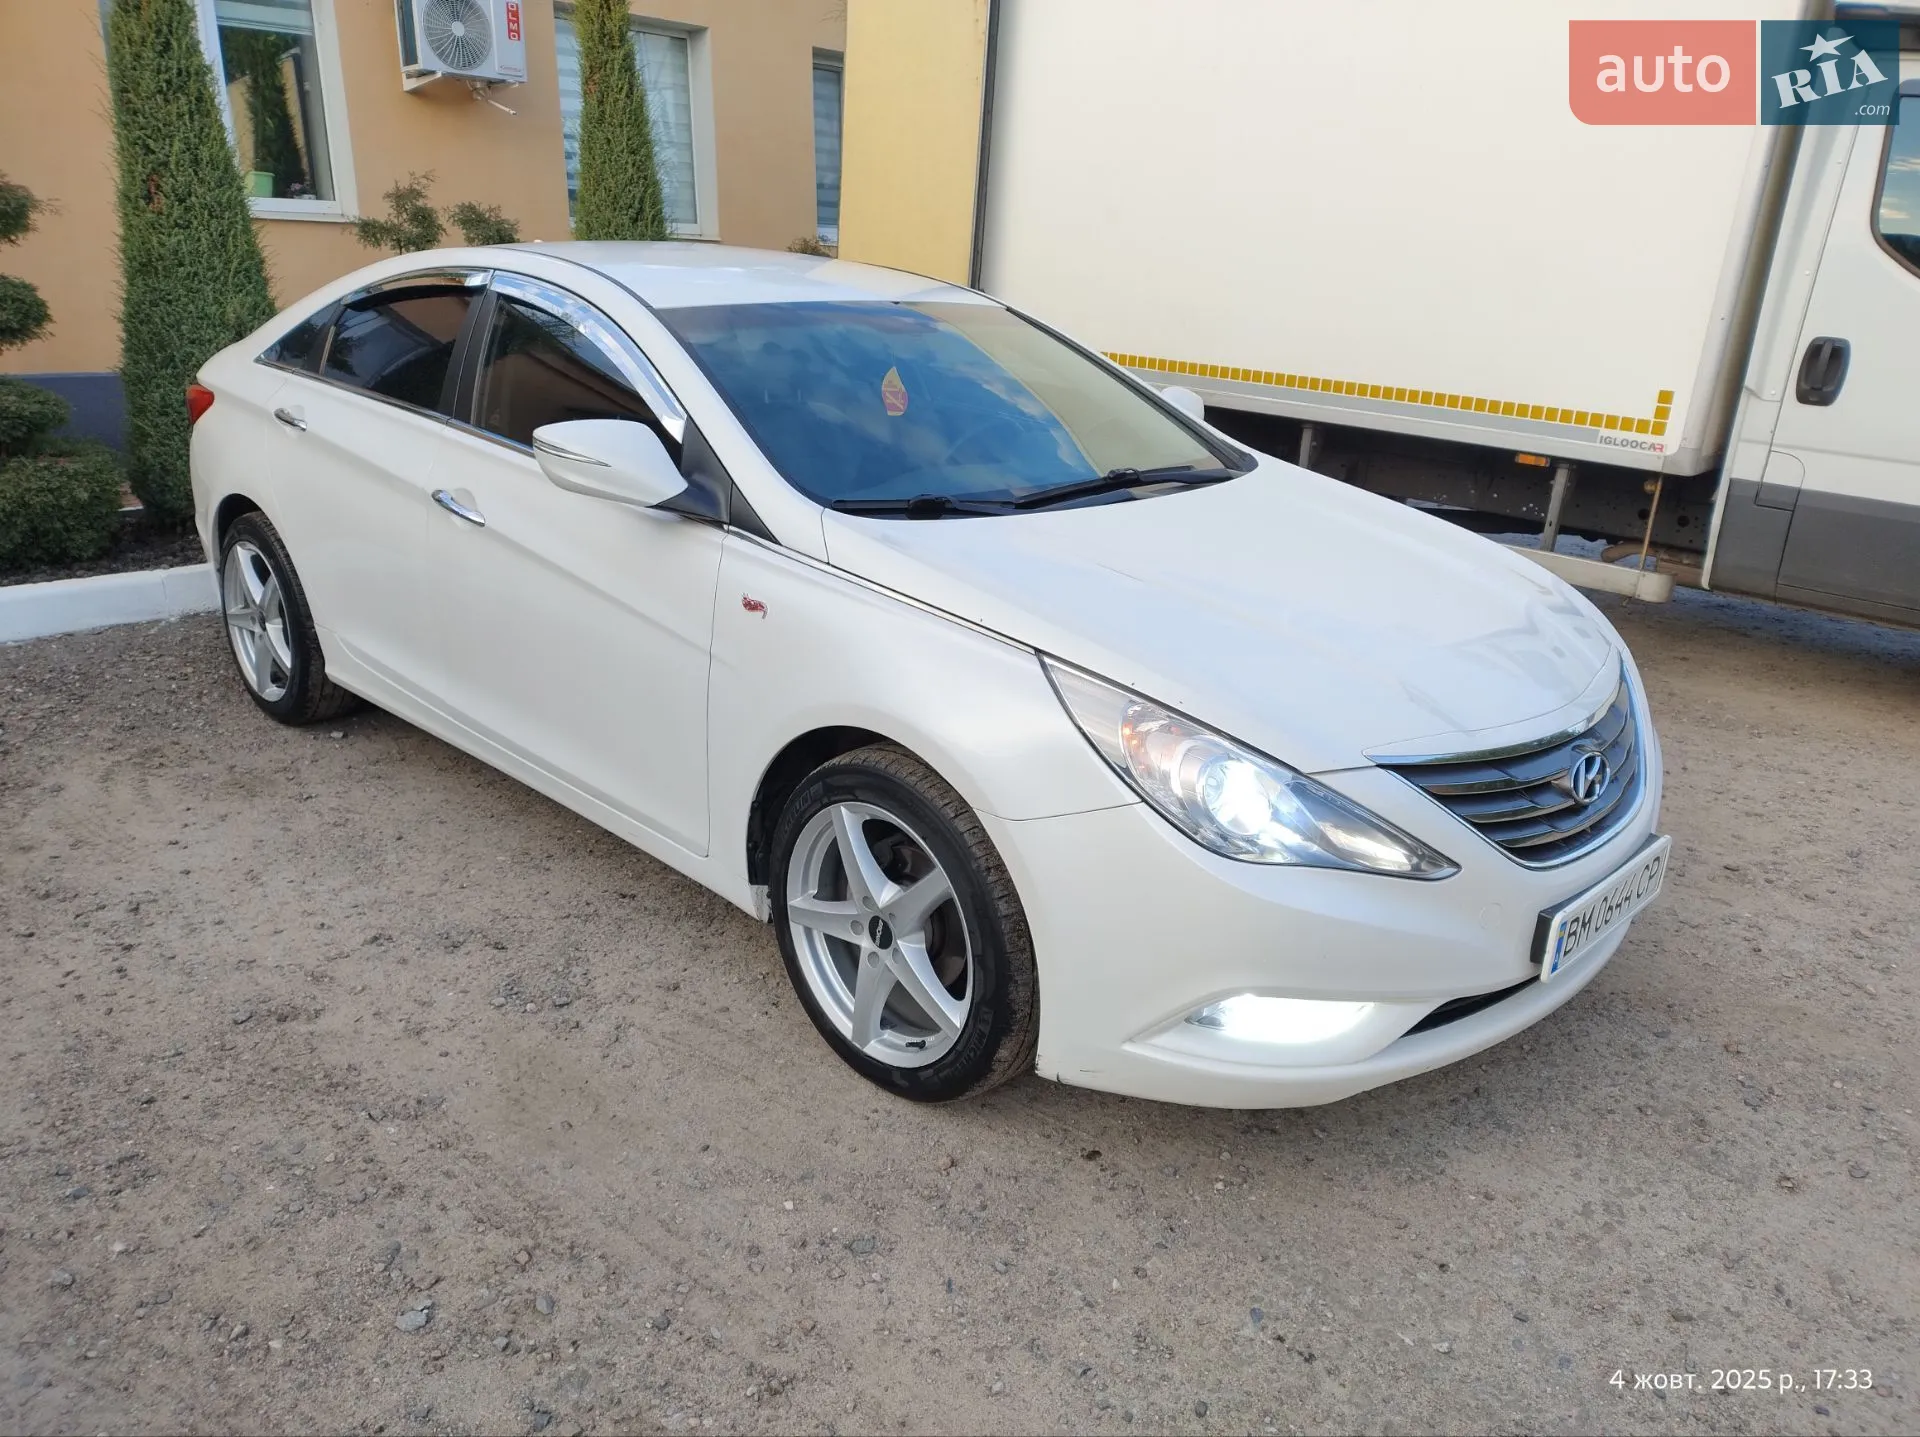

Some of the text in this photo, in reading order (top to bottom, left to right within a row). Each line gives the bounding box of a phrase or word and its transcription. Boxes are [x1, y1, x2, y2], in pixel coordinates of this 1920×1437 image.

[1600, 435, 1664, 452] IGLOOCAR
[1564, 855, 1661, 957] BM 0644 CP
